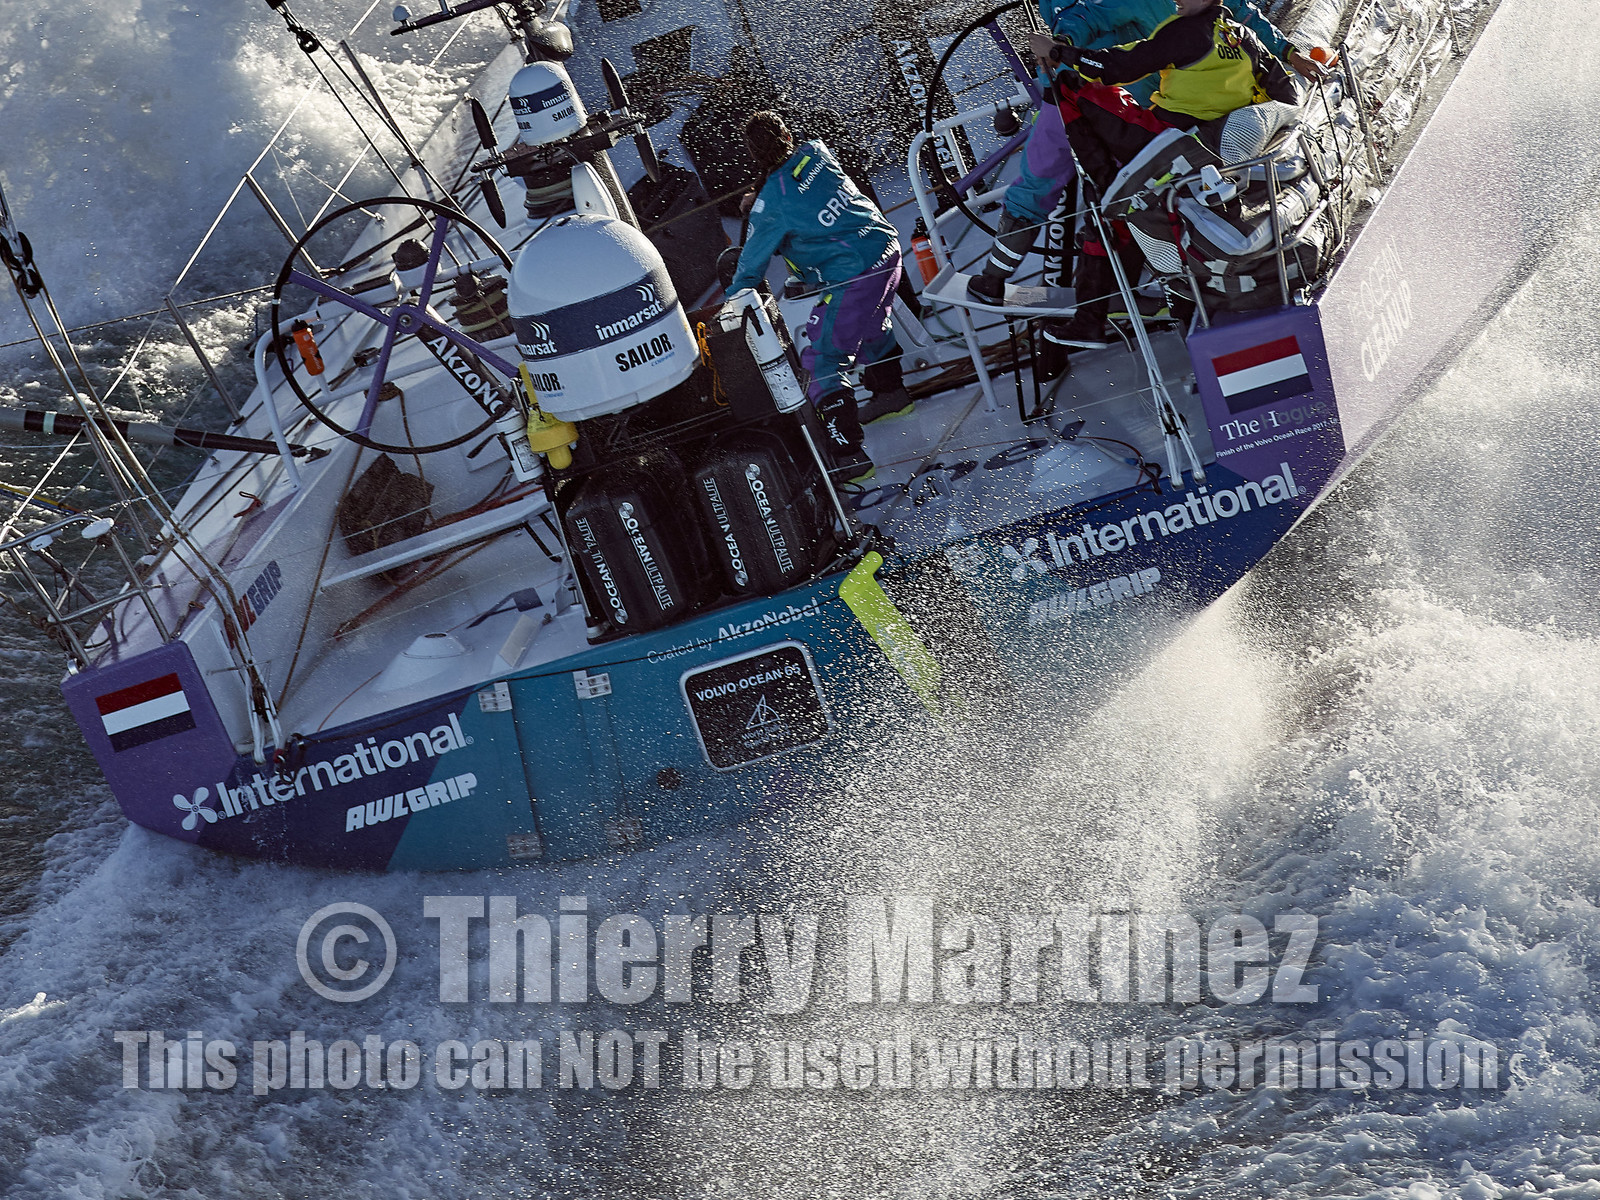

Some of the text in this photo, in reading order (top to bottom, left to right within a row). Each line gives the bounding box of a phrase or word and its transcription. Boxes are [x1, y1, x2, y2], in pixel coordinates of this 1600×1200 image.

[1217, 44, 1243, 60] OBR
[595, 299, 665, 341] inmarsat
[615, 333, 673, 372] SAILOR
[531, 372, 562, 391] AILOR
[1216, 447, 1236, 458] Finish
[1244, 442, 1255, 450] the
[1254, 437, 1273, 447] Volvo
[1273, 430, 1295, 442] Ocean
[1294, 426, 1312, 436] Race
[1219, 419, 1261, 441] The
[1046, 462, 1299, 568] International
[647, 597, 822, 664] Coated by AkzoNobel
[696, 664, 801, 701] VOLVO OCEAN 65
[215, 712, 468, 818] International
[345, 772, 478, 833] AWLGRIP
